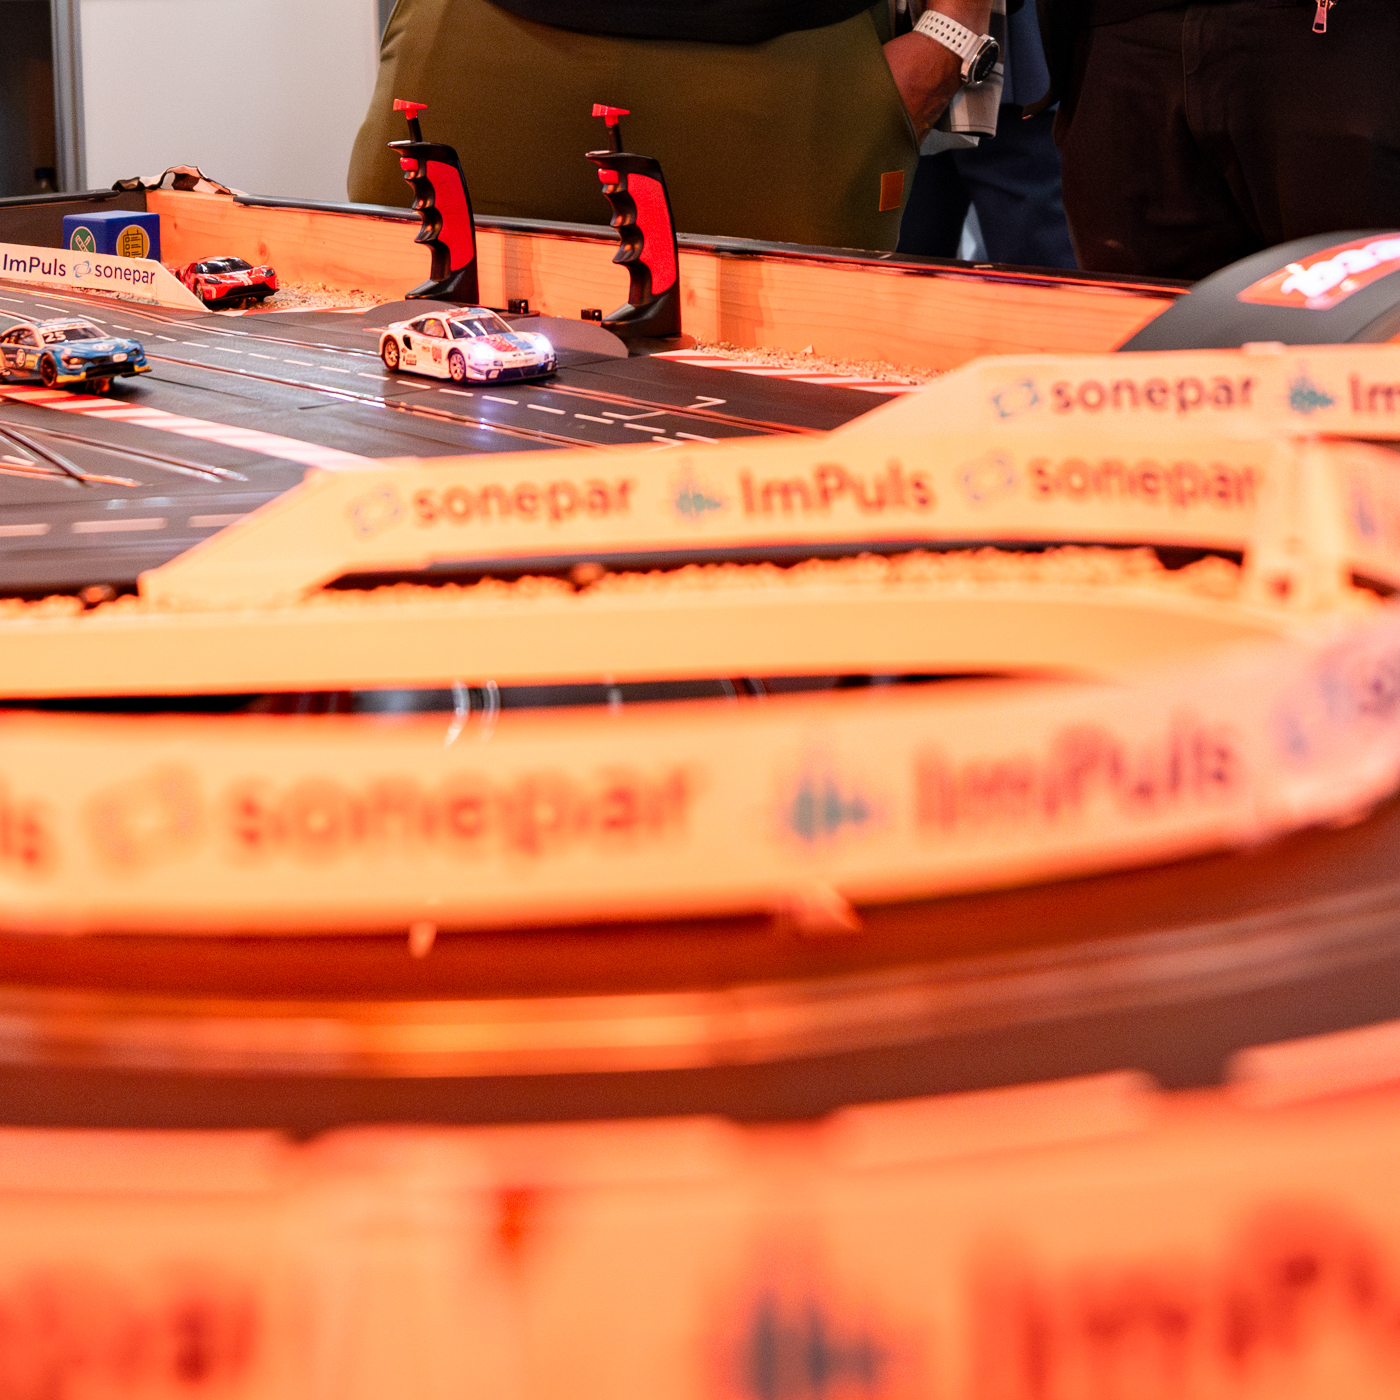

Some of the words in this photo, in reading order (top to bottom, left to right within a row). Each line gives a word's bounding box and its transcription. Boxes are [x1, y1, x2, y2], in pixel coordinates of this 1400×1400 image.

[2, 253, 67, 277] ImPuls
[94, 261, 156, 285] sonepar
[44, 331, 67, 344] 25
[1049, 370, 1255, 422] sonepar
[410, 470, 635, 530] sonepar
[737, 462, 937, 521] ImPuls
[1024, 447, 1261, 514] sonepar
